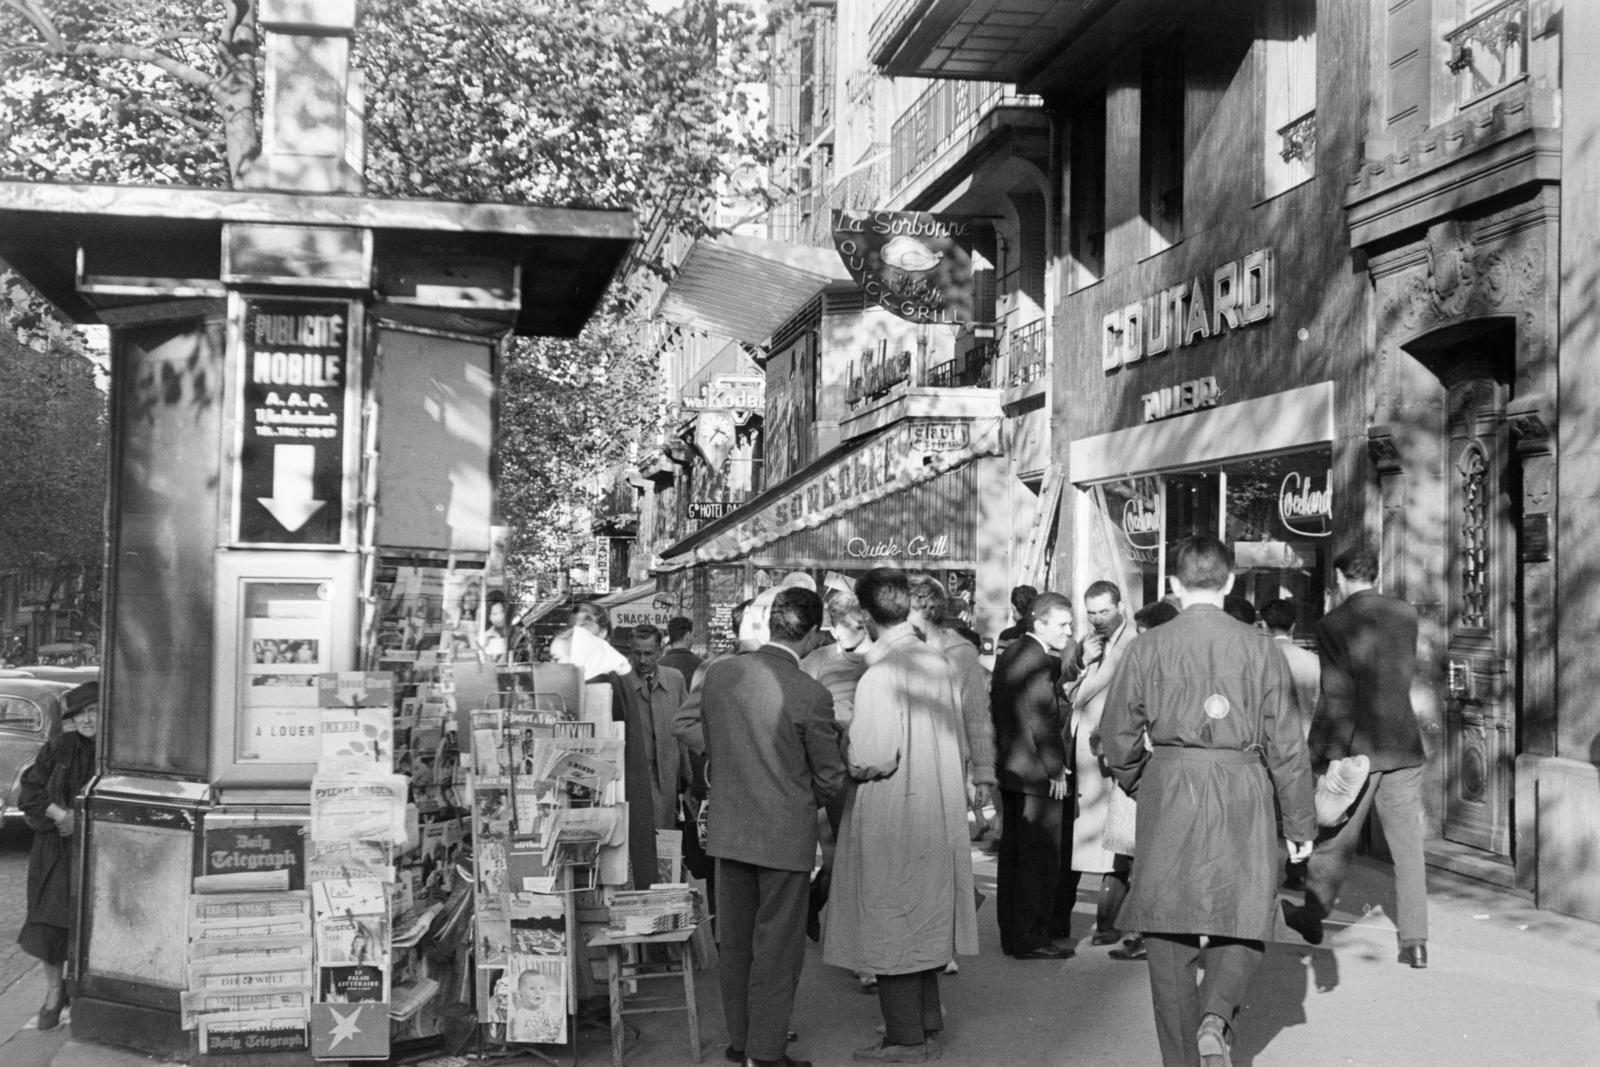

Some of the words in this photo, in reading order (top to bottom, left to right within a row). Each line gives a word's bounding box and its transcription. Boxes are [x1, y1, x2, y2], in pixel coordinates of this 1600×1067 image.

[834, 211, 864, 232] La
[872, 211, 972, 237] Sorbonne
[1102, 247, 1275, 372] COUTARD
[255, 314, 343, 347] PUBLICITÉ
[253, 351, 340, 387] MOBILE
[701, 503, 722, 518] HOTEL
[847, 537, 902, 557] Quick
[907, 535, 950, 558] Grill
[255, 726, 262, 736] A
[271, 726, 315, 737] LOUER
[235, 835, 271, 851] Daily
[211, 850, 296, 869] Telegraph
[255, 974, 283, 985] WELT
[246, 1033, 304, 1049] Telegraph
